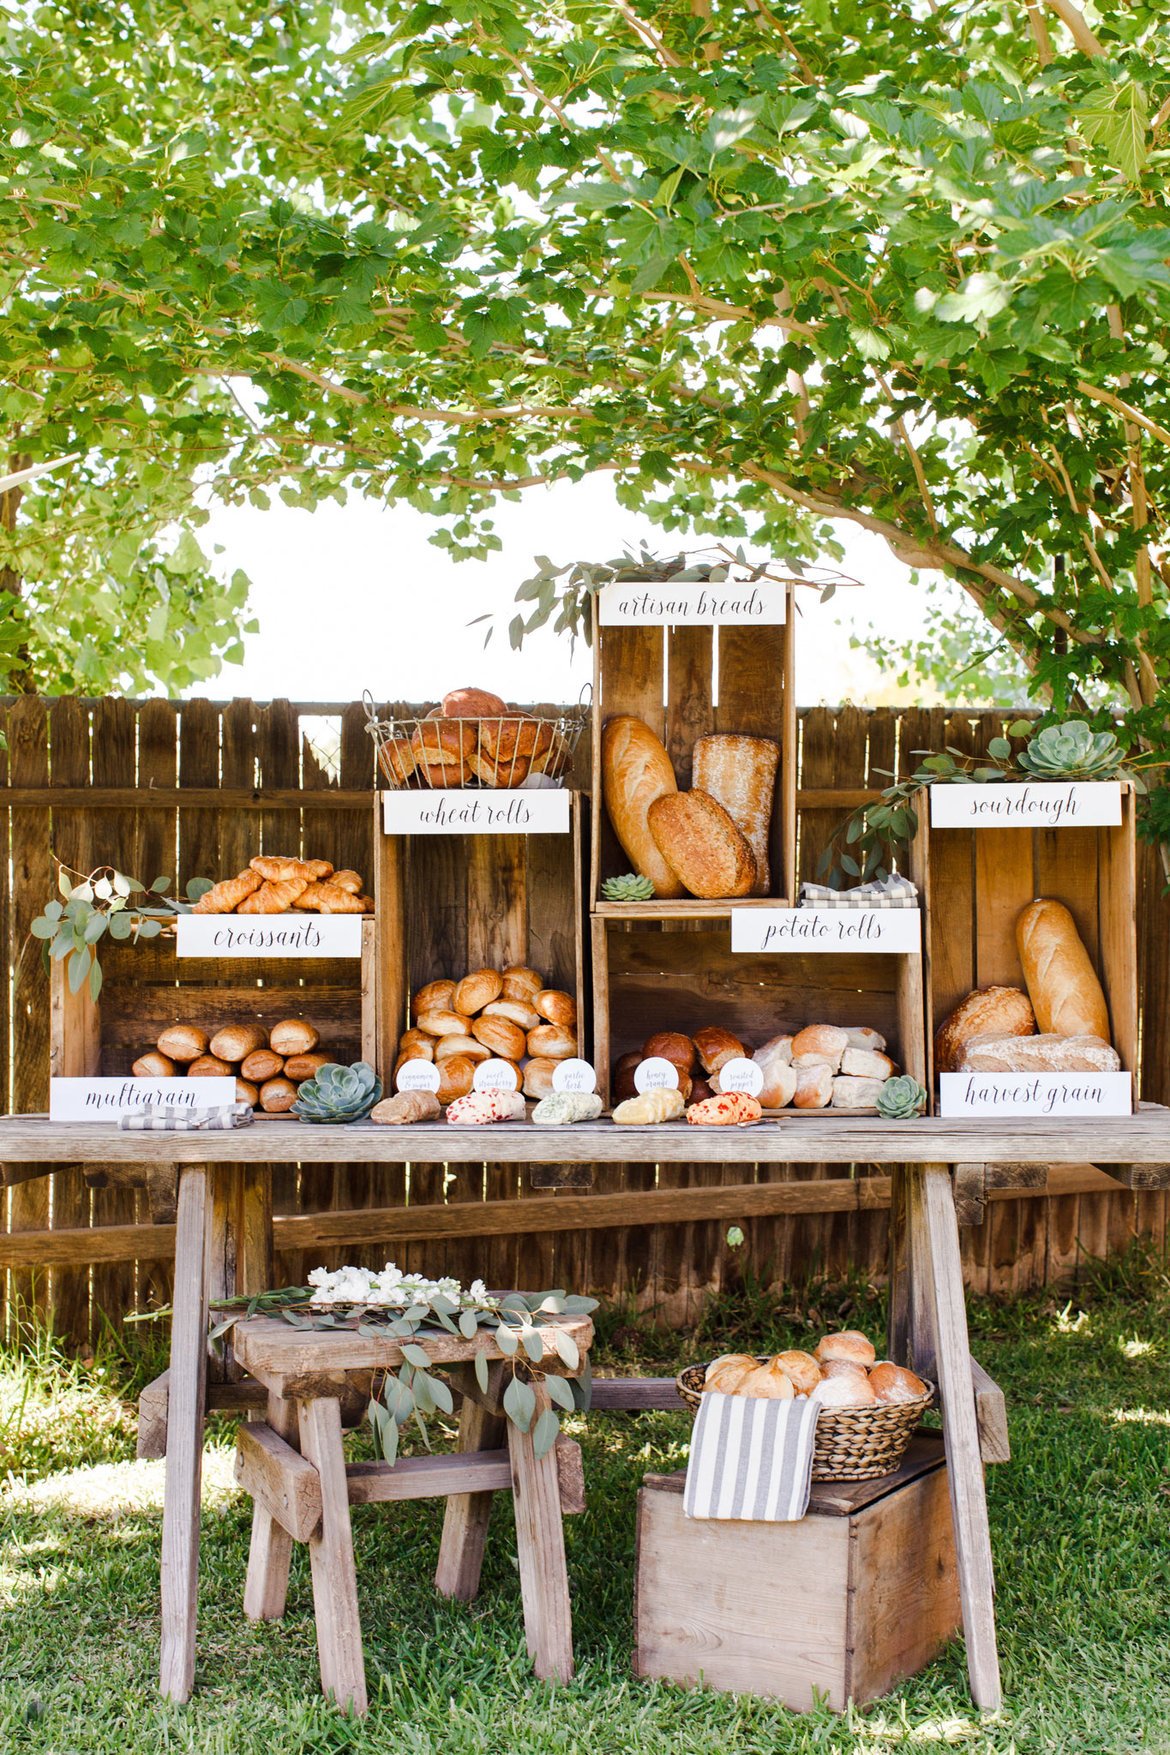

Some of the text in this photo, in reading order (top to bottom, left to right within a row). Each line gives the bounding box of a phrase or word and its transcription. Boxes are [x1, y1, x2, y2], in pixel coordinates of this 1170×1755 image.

[618, 588, 765, 617] artisan breads
[419, 797, 533, 826] wheat rolls
[971, 786, 1079, 823] sourdough
[213, 921, 323, 949] croissants
[761, 914, 884, 949] potato rolls
[646, 1069, 666, 1081] honey
[964, 1077, 1105, 1111] harvest grain
